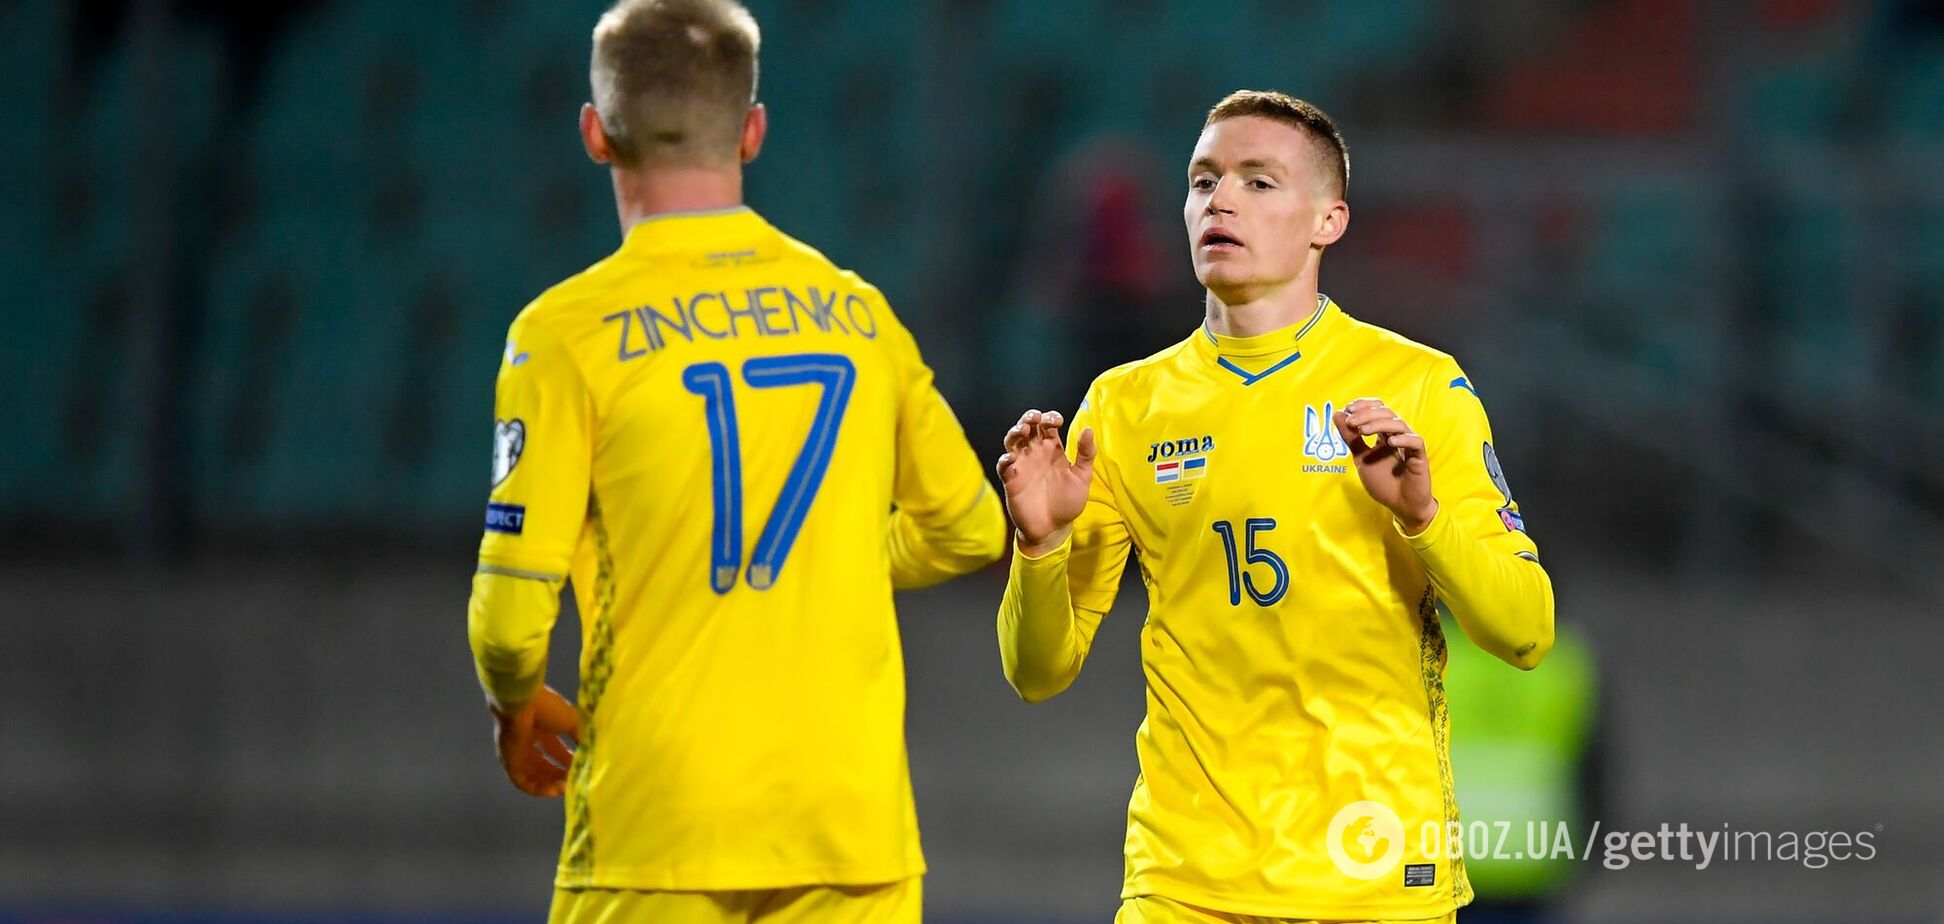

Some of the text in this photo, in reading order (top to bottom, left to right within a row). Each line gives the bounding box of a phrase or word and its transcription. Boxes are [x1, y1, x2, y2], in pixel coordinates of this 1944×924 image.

[602, 286, 876, 362] ZINCHENKO
[683, 353, 856, 594] 17
[1302, 464, 1348, 474] UKRAINE
[1212, 518, 1290, 607] 15
